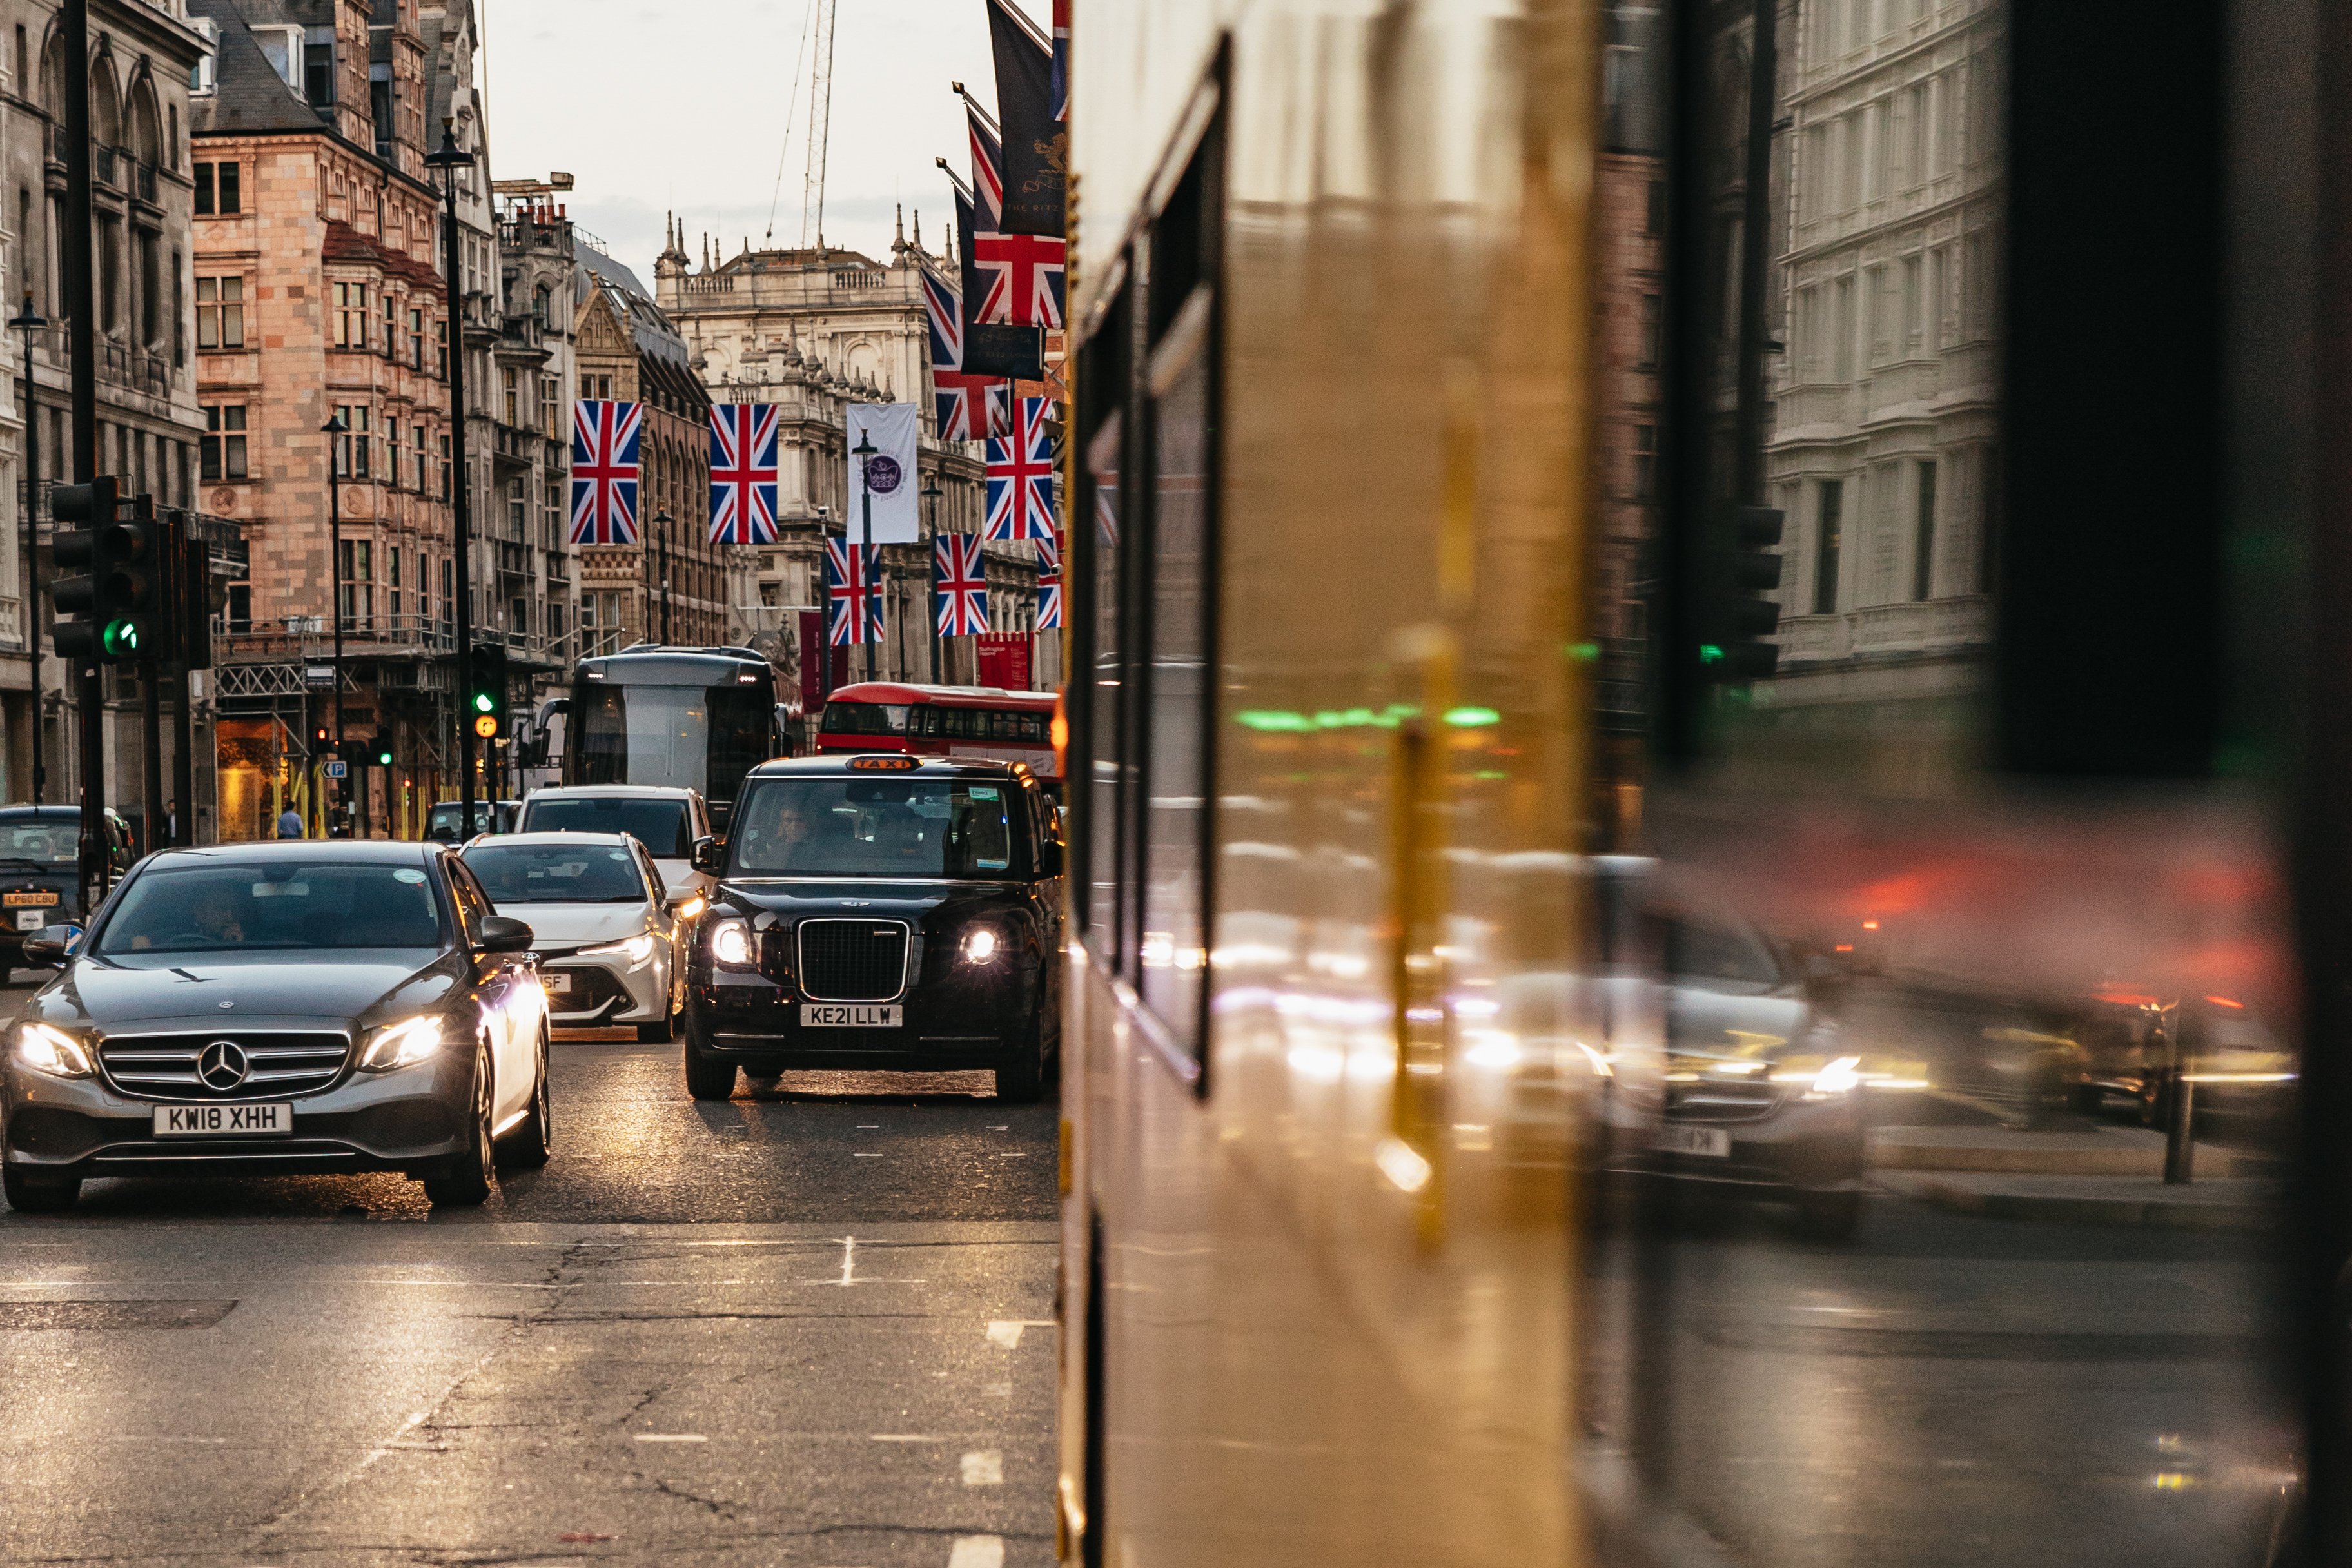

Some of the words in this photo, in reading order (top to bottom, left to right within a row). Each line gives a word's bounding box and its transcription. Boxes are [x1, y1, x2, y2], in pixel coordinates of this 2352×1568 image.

[858, 760, 906, 768] TAXI
[335, 765, 343, 774] P
[8, 894, 34, 904] LP60
[811, 1007, 850, 1024] KE21
[856, 1007, 891, 1024] LLW
[169, 1108, 222, 1130] KW18
[230, 1106, 277, 1129] XHH
